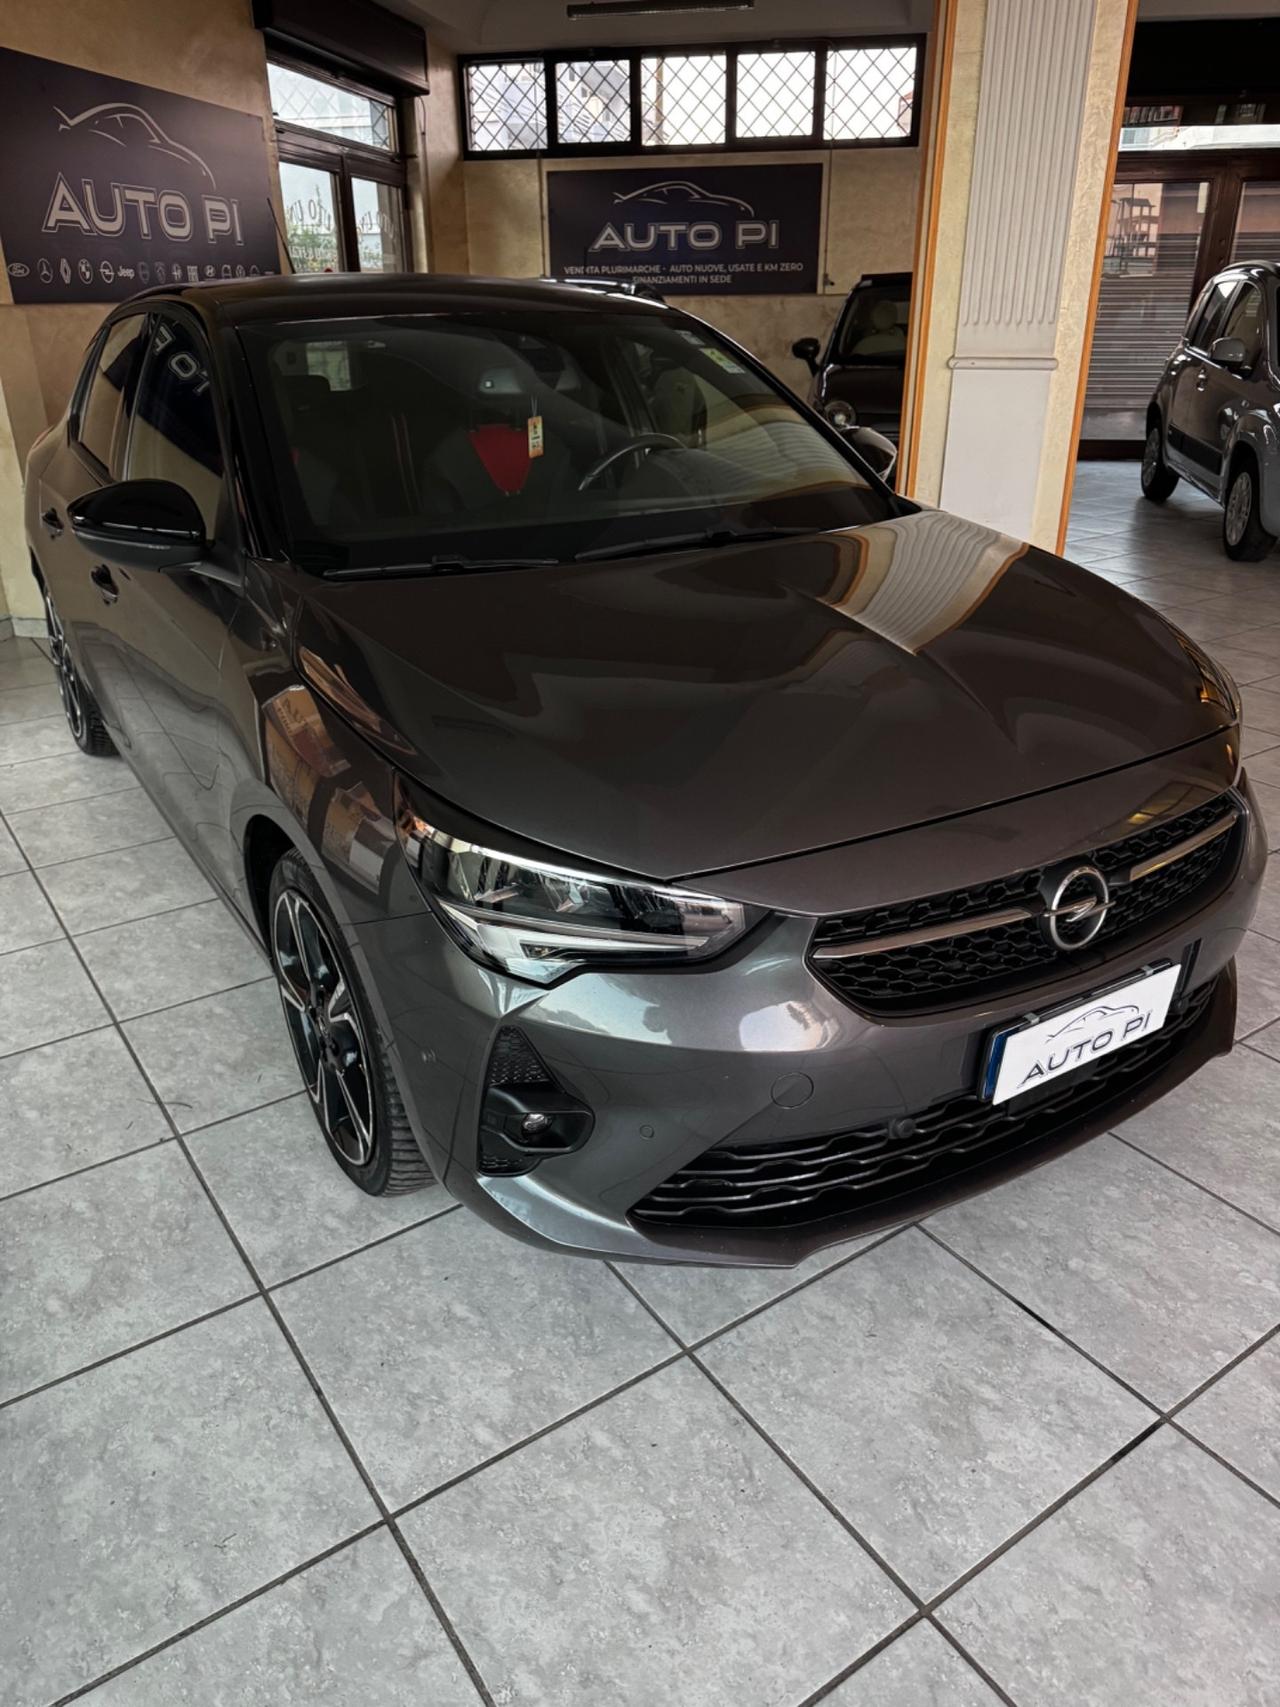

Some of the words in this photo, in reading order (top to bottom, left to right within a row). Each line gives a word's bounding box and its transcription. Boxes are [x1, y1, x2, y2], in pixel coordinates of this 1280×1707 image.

[41, 172, 193, 241] AUTO
[201, 194, 245, 246] PI
[588, 221, 722, 251] AUTO
[735, 219, 780, 250] PI
[117, 265, 135, 279] Jeep
[601, 264, 661, 274] PLURIMARCHE
[669, 264, 694, 273] AUTO
[728, 263, 755, 272] USATE
[757, 263, 763, 271] E
[764, 263, 778, 271] KM
[779, 262, 803, 271] ZERO
[699, 275, 708, 283] IN
[709, 275, 732, 283] SEDE
[1016, 1028, 1115, 1089] AUTO
[1121, 1009, 1153, 1041] PI
